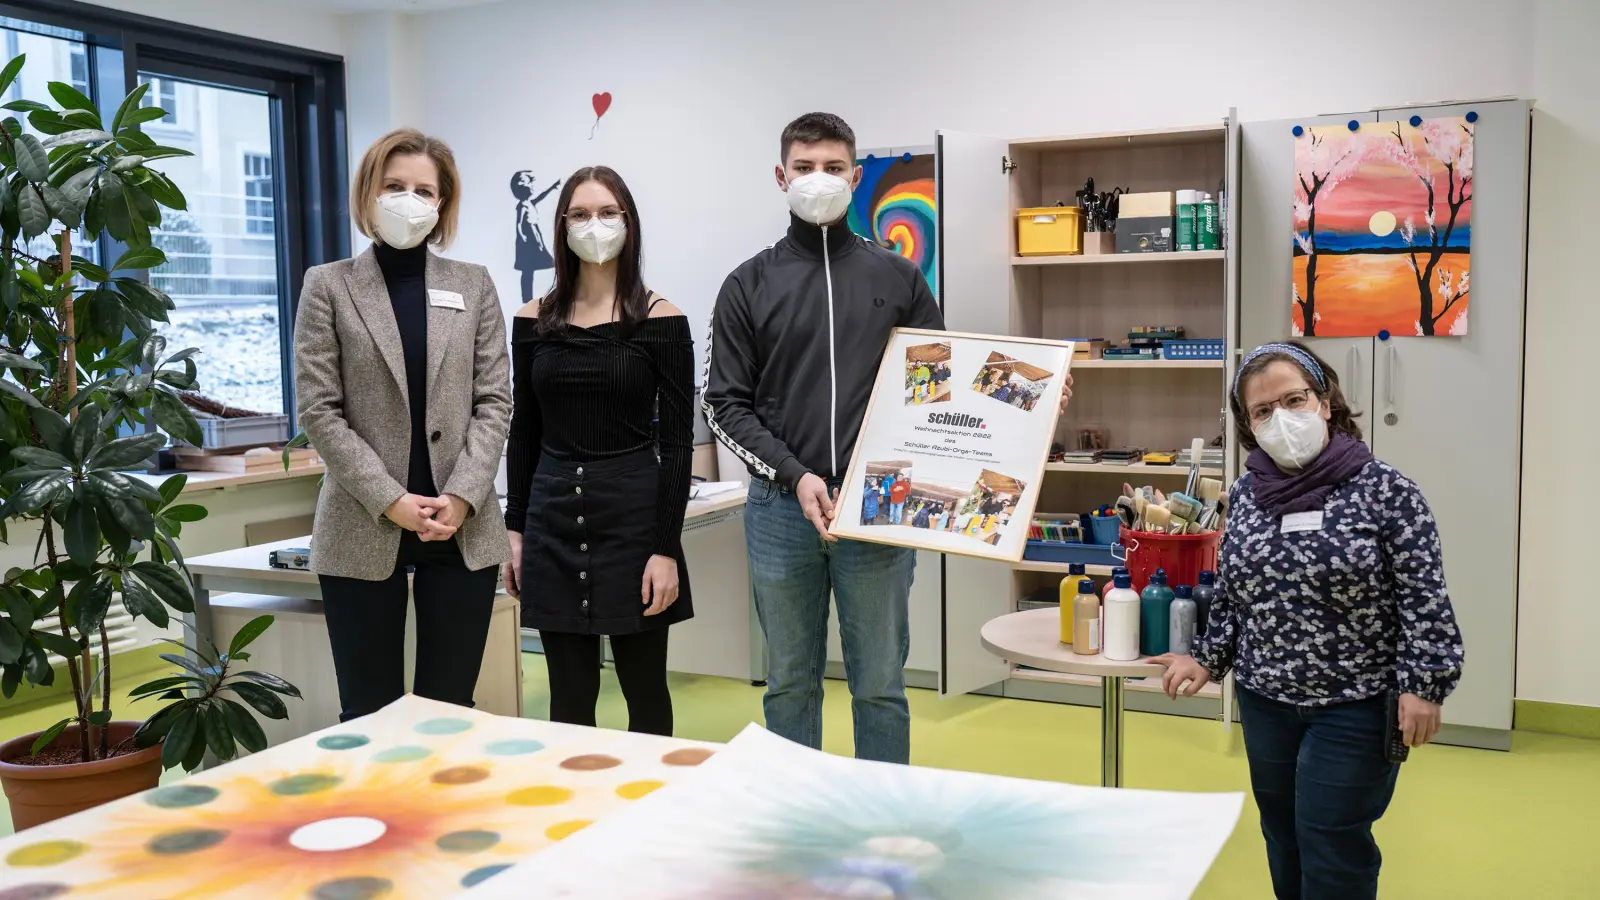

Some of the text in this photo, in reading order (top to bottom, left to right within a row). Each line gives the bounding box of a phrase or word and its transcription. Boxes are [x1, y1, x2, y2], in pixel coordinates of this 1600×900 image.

[1204, 204, 1213, 233] guardi
[928, 412, 986, 429] schüller.
[914, 426, 992, 440] Weihnachtsaktion 2022
[904, 441, 931, 449] Schüller
